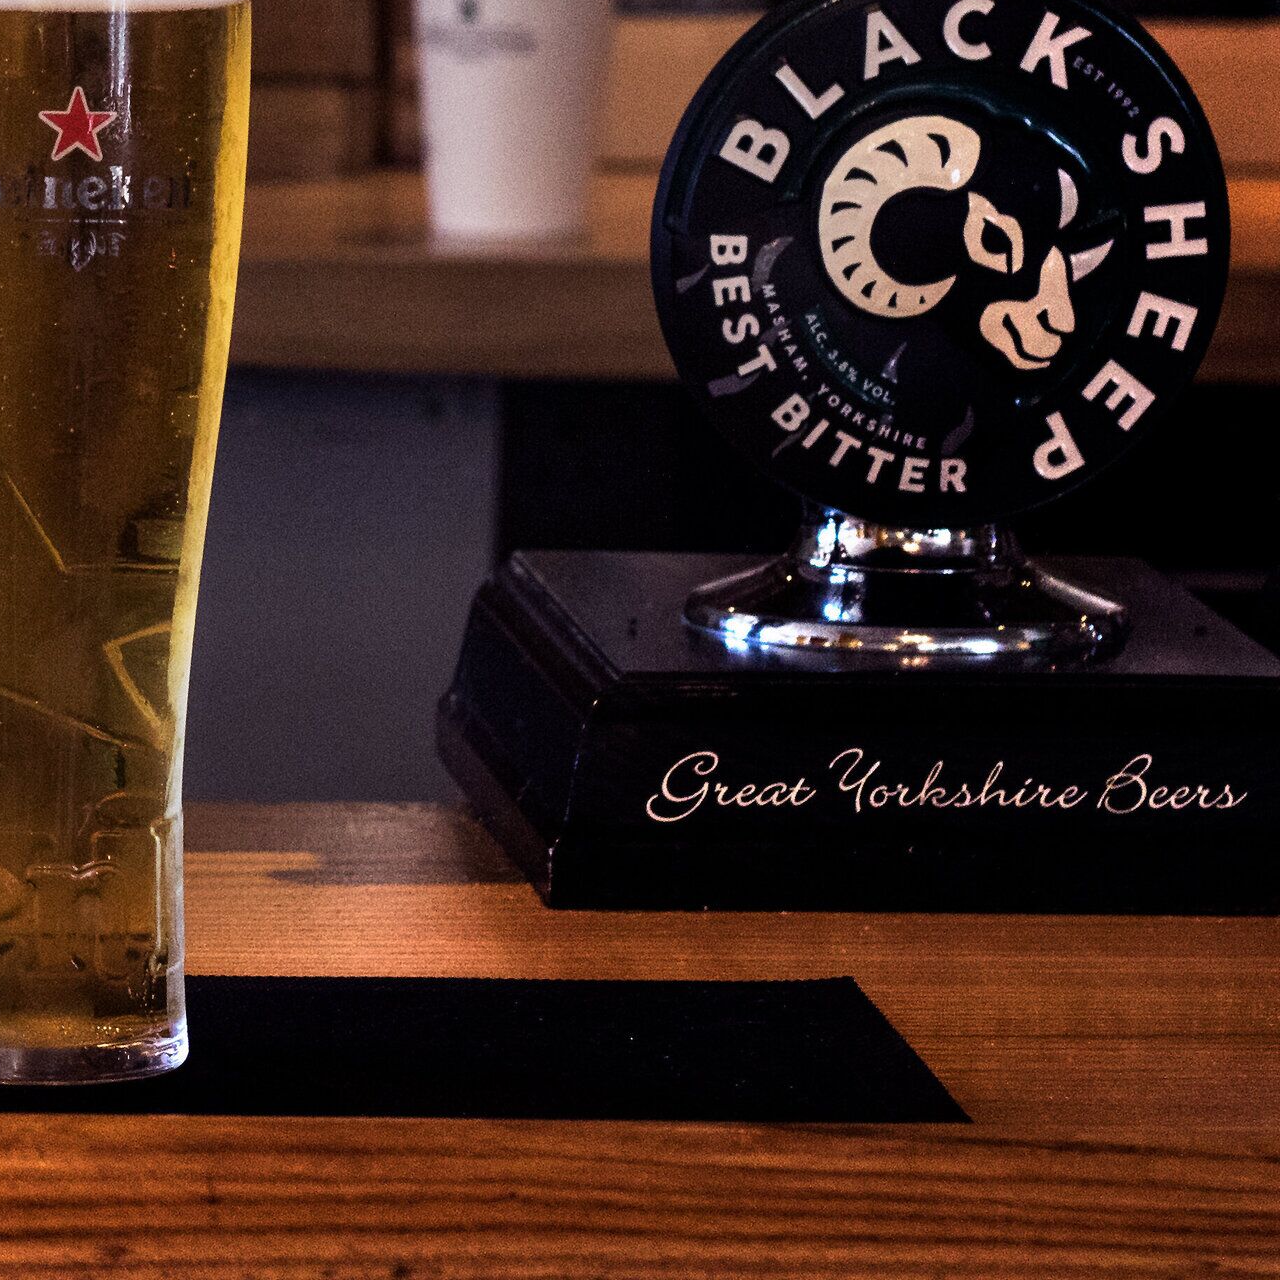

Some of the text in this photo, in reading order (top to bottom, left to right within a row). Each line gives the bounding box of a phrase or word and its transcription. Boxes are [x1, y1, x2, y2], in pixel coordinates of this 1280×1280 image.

[1073, 55, 1140, 118] EST 1992
[710, 234, 967, 493] BEST BITTER
[762, 284, 927, 449] MASHAM, YORKSHIRE
[1032, 116, 1209, 481] SHEEP
[646, 747, 1248, 822] Great Yorkshire Beers
